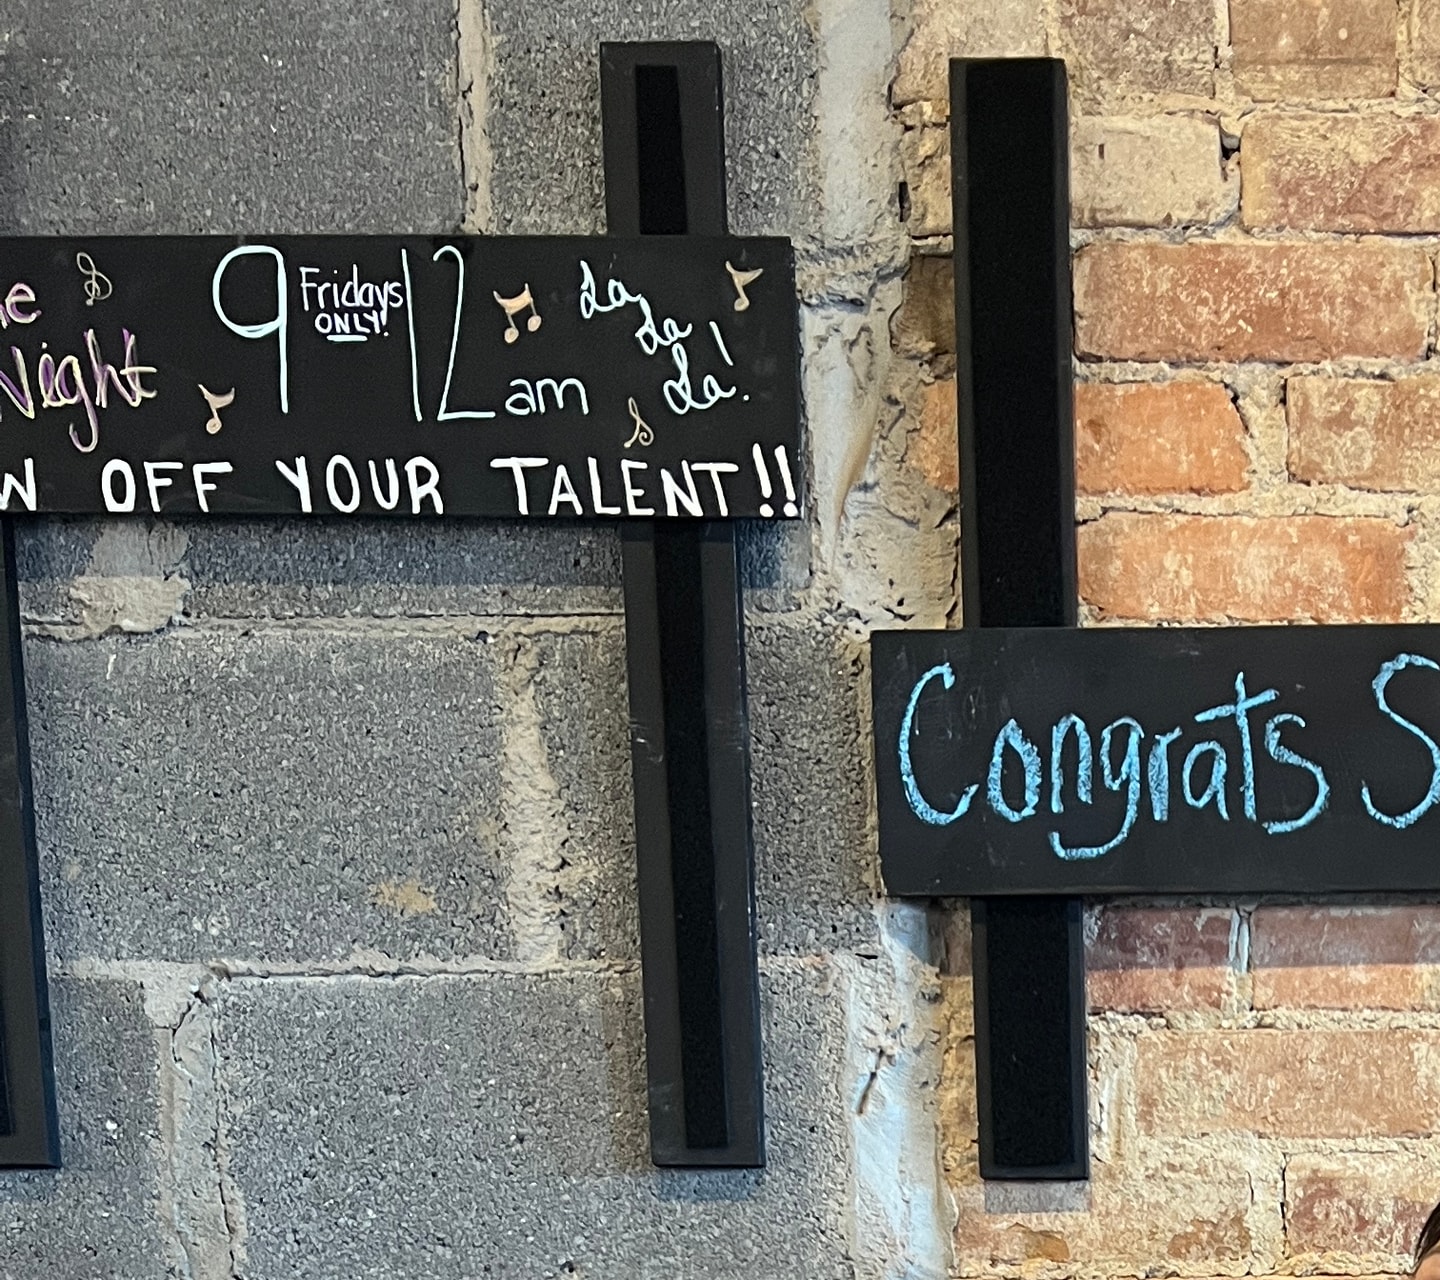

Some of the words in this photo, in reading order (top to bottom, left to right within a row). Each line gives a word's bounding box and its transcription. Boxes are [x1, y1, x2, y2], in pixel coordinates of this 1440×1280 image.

[0, 282, 42, 329] e
[299, 264, 404, 326] Fridays
[212, 245, 289, 414] 9
[401, 245, 496, 421] 12
[505, 378, 590, 416] am
[101, 458, 234, 513] OFF
[275, 455, 444, 515] YOUR
[490, 443, 799, 518] TALENT!!
[898, 661, 1331, 860] Congrats
